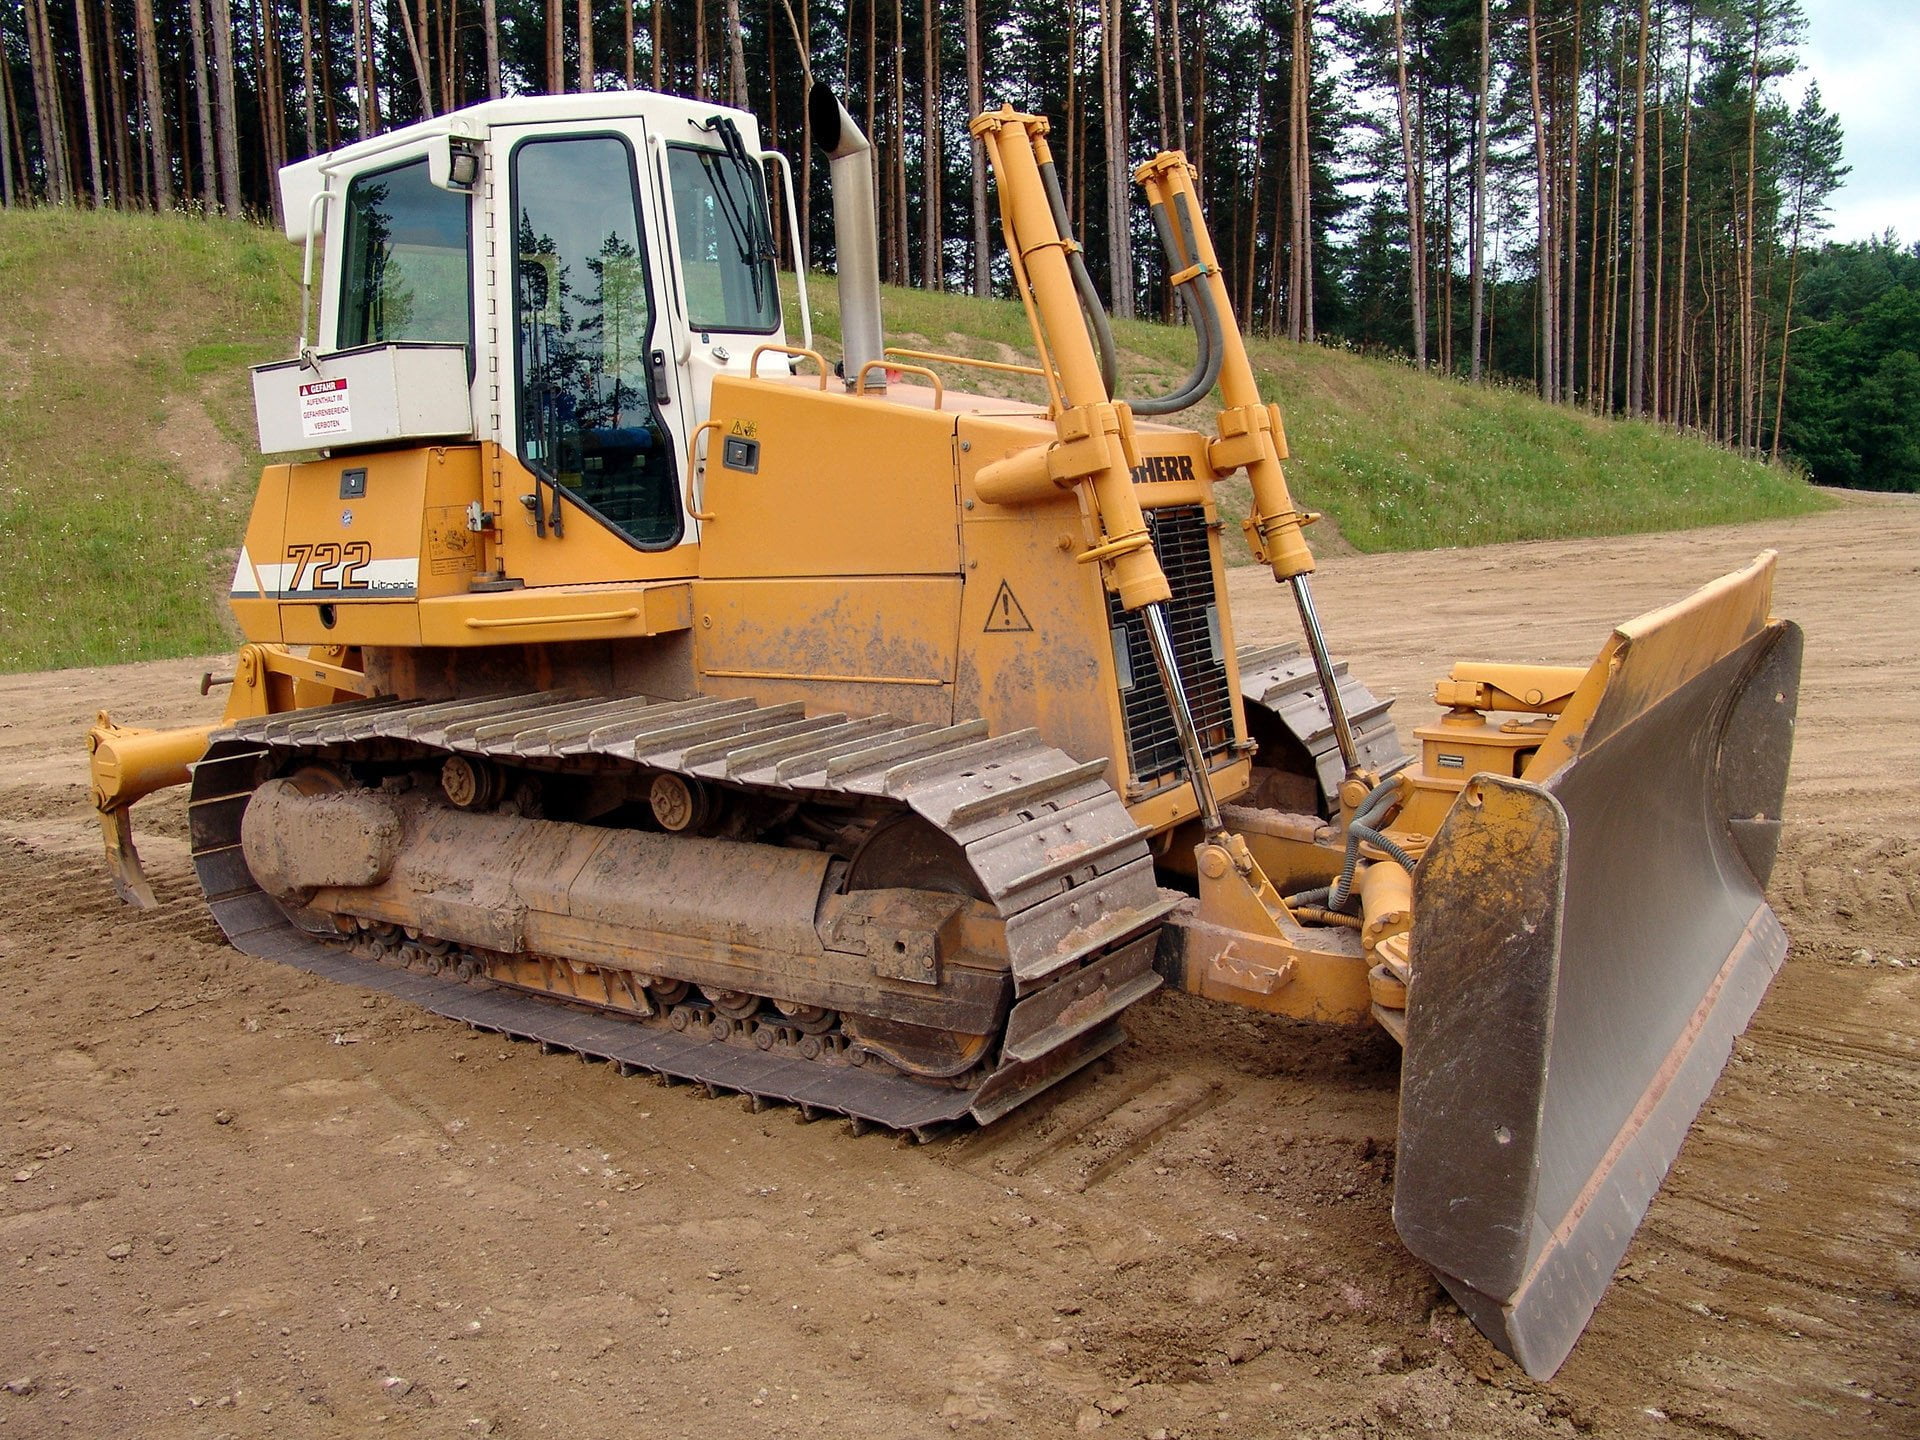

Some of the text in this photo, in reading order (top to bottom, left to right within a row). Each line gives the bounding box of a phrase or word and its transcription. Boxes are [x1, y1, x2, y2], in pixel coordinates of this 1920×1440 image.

[310, 381, 336, 393] GEFAHR
[307, 396, 336, 405] AUFENTHALT
[315, 420, 340, 429] VERBOTEN
[287, 541, 415, 591] 722 Litronic
